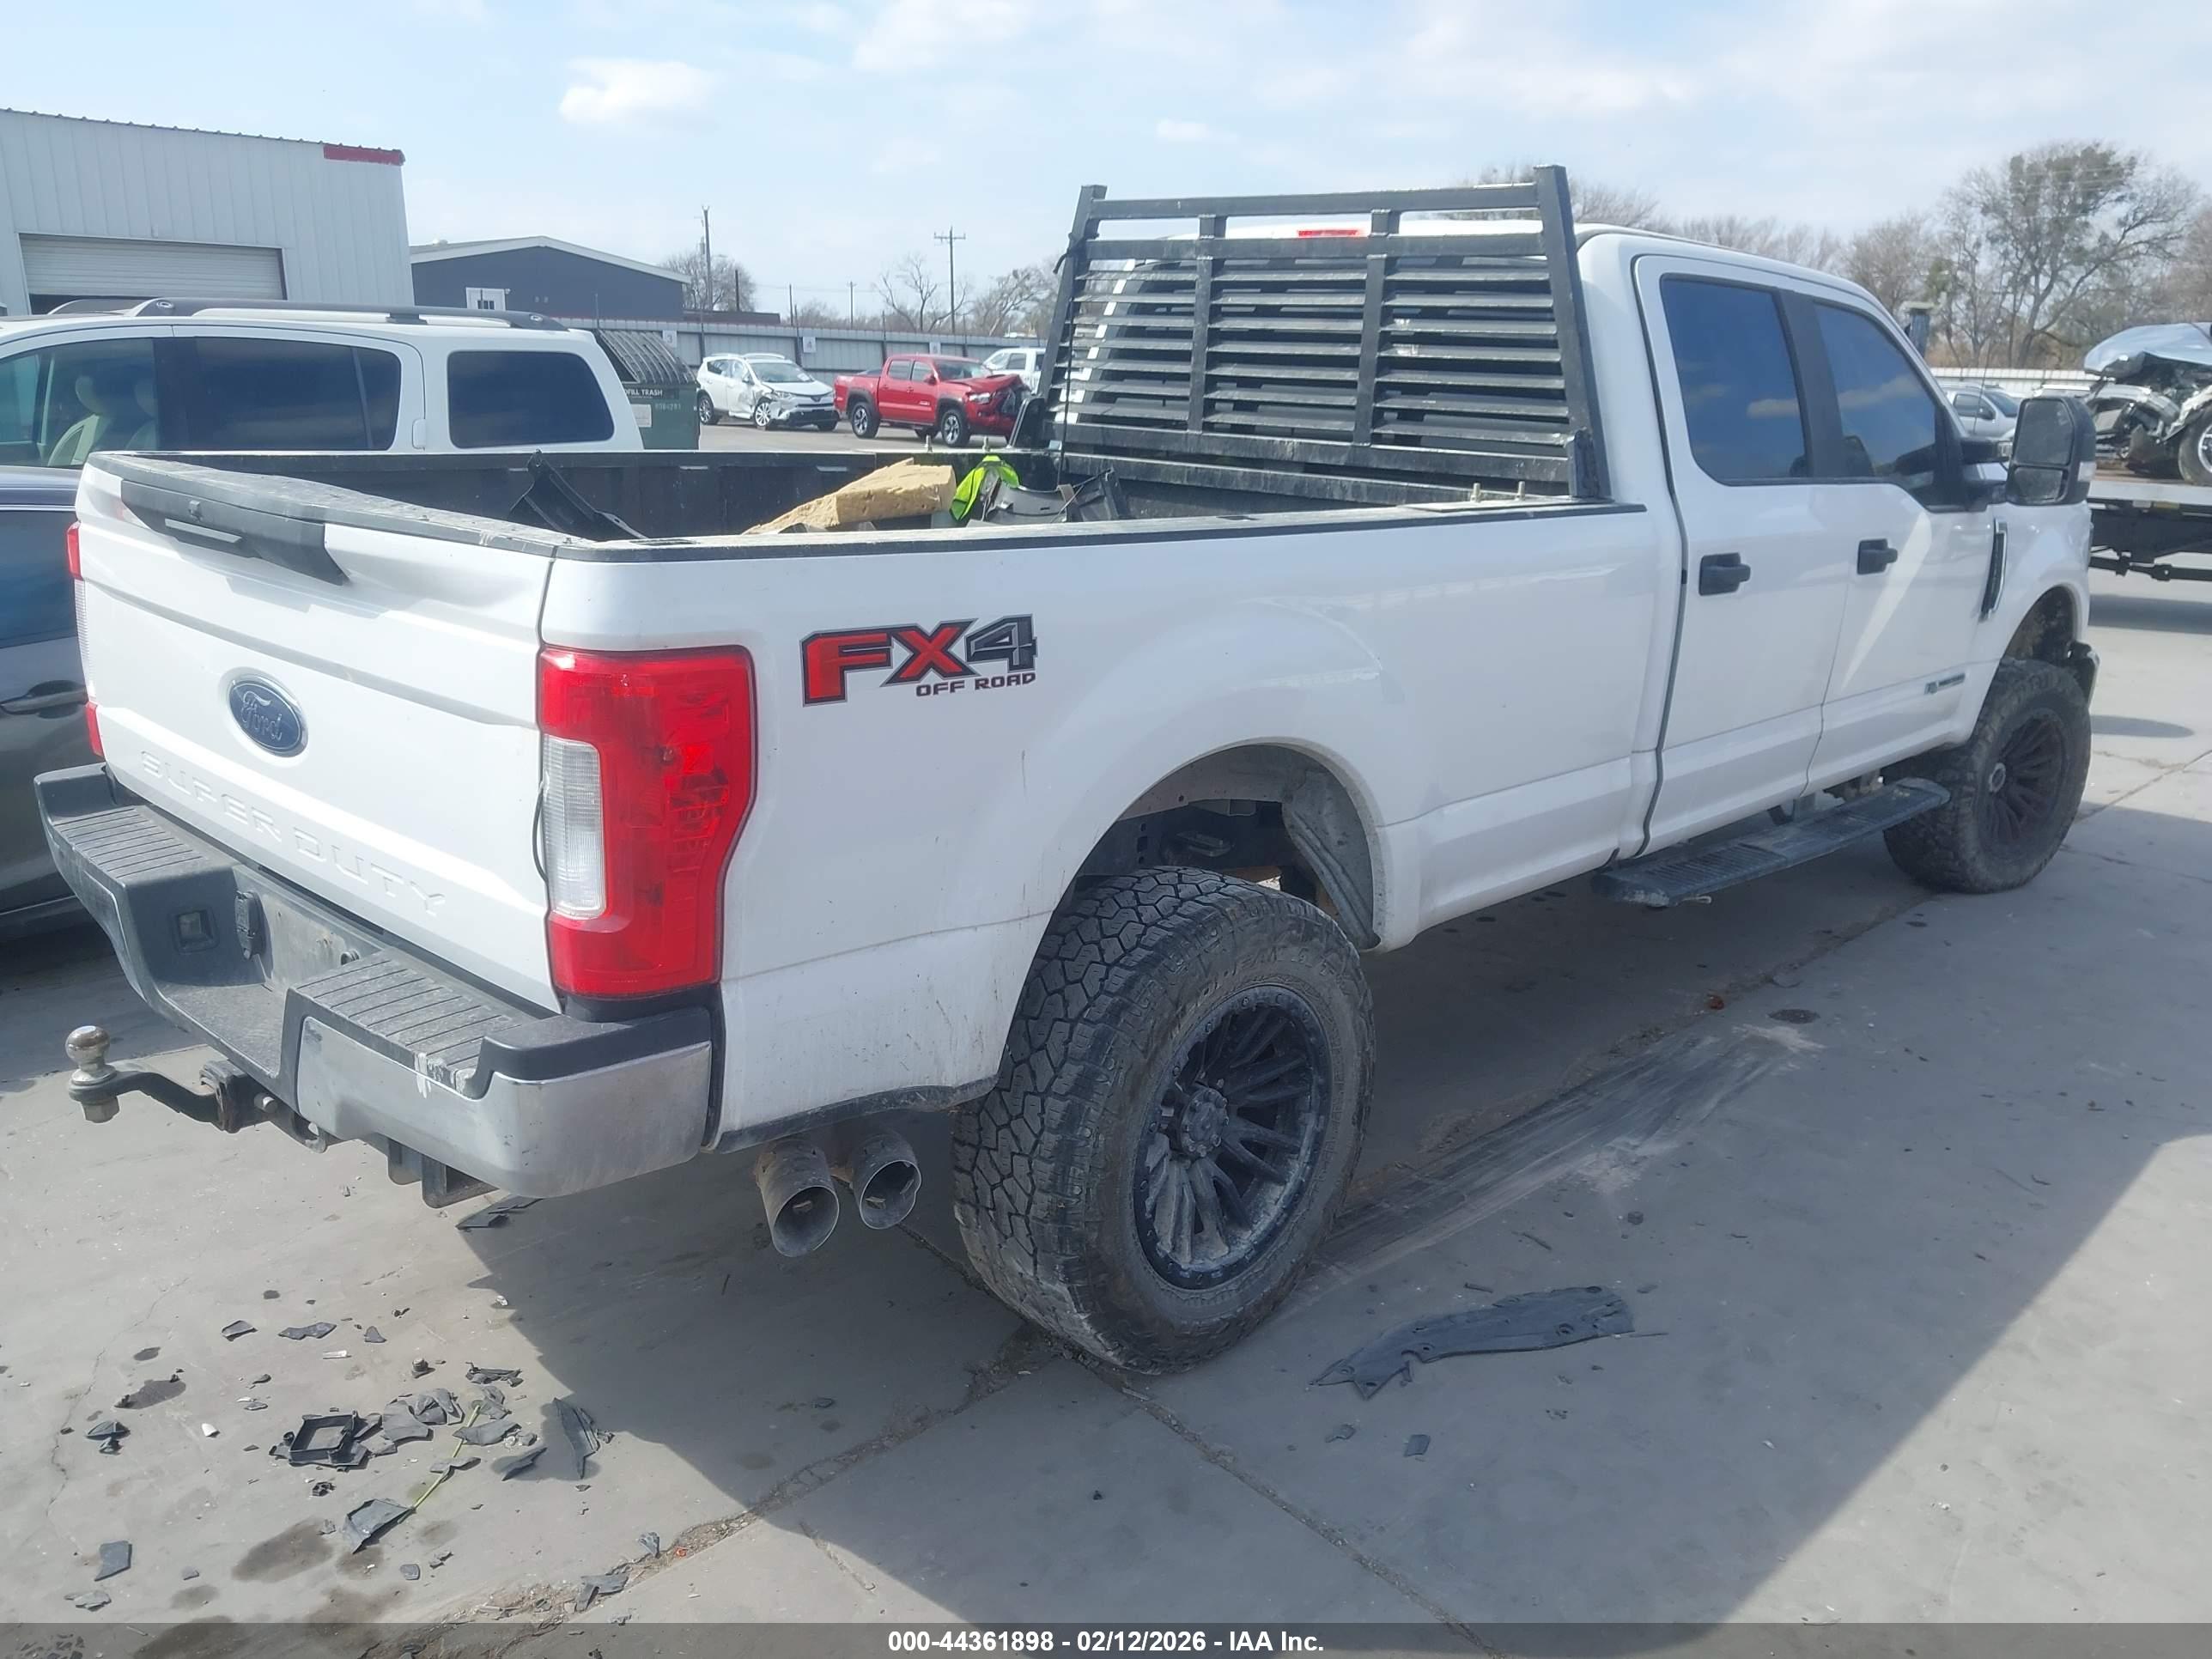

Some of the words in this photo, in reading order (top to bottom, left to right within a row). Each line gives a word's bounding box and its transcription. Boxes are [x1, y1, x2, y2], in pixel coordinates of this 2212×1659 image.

[799, 613, 1037, 708] FX4
[915, 679, 965, 697] OFF
[974, 672, 1036, 690] ROAD
[240, 690, 283, 742] Ford
[141, 750, 283, 842] SUPER
[294, 826, 447, 916] DUTY
